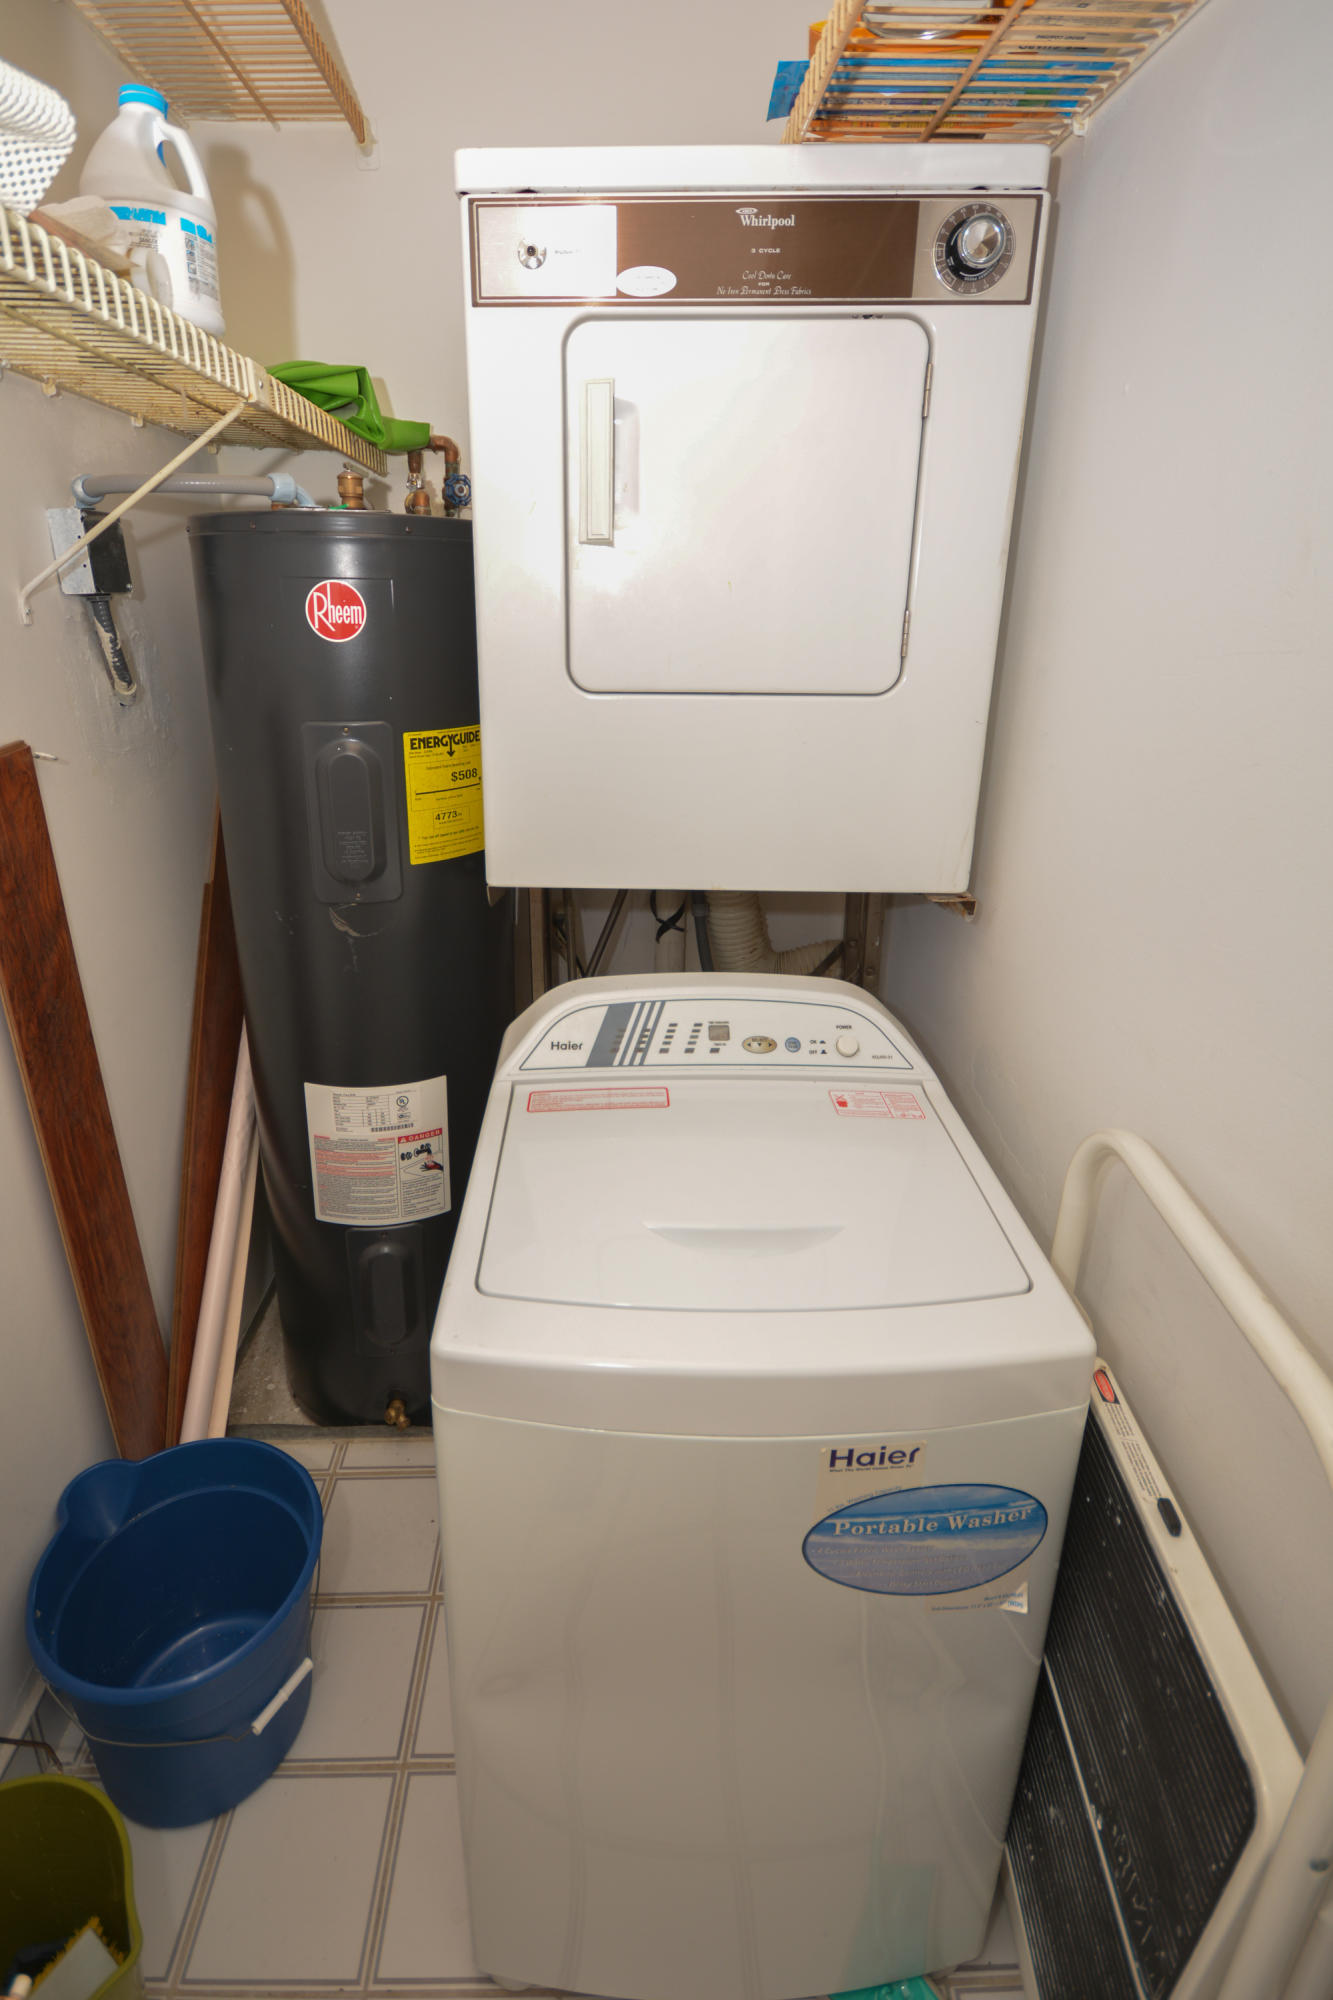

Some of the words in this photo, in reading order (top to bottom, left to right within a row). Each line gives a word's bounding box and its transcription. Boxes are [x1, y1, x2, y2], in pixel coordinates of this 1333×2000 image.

[740, 214, 795, 229] Whirlpool
[742, 270, 757, 280] Cool
[740, 285, 772, 295] Permanent
[773, 285, 790, 295] Press
[791, 286, 812, 295] Fabrics
[313, 583, 362, 631] Rheem
[409, 730, 481, 752] ENERGYGUIDE
[451, 767, 478, 782] $508
[434, 811, 458, 821] 4773
[550, 1040, 583, 1050] Haier
[408, 1129, 441, 1141] DANGER
[829, 1445, 920, 1468] Haier
[833, 1518, 938, 1536] Portable
[948, 1508, 1032, 1530] Washer
